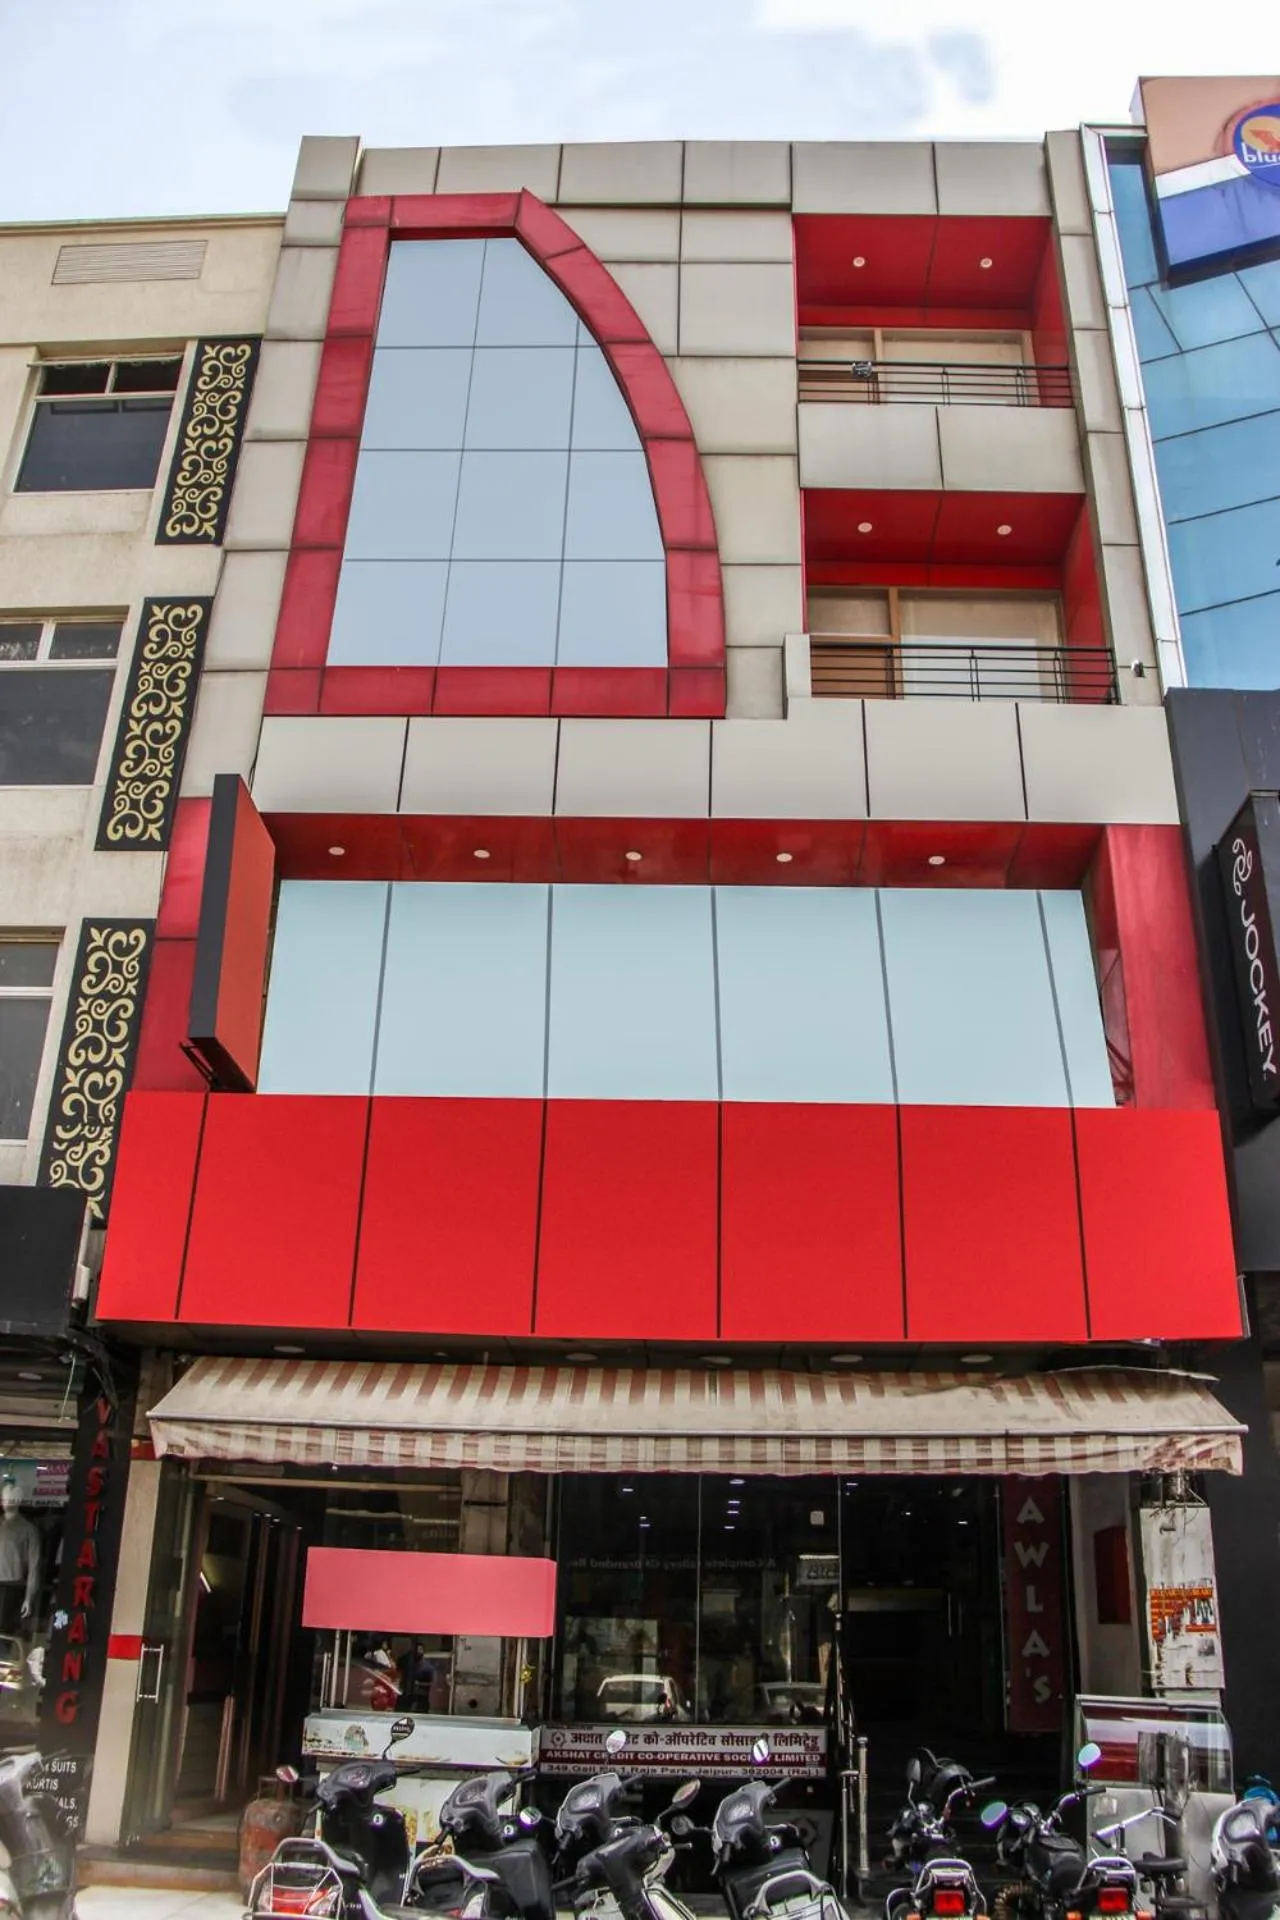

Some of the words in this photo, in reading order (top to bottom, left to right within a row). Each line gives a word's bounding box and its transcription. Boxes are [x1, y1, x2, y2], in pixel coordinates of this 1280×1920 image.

[1241, 141, 1280, 163] blu
[1241, 899, 1276, 1074] JOCKEY
[55, 1396, 110, 1725] VASTARANG
[1012, 1478, 1053, 1704] AWLA'S
[51, 1760, 77, 1774] SUITS
[546, 1750, 591, 1759] AKSHAT
[723, 1753, 771, 1762] SOCIY
[774, 1754, 821, 1762] LIMITED
